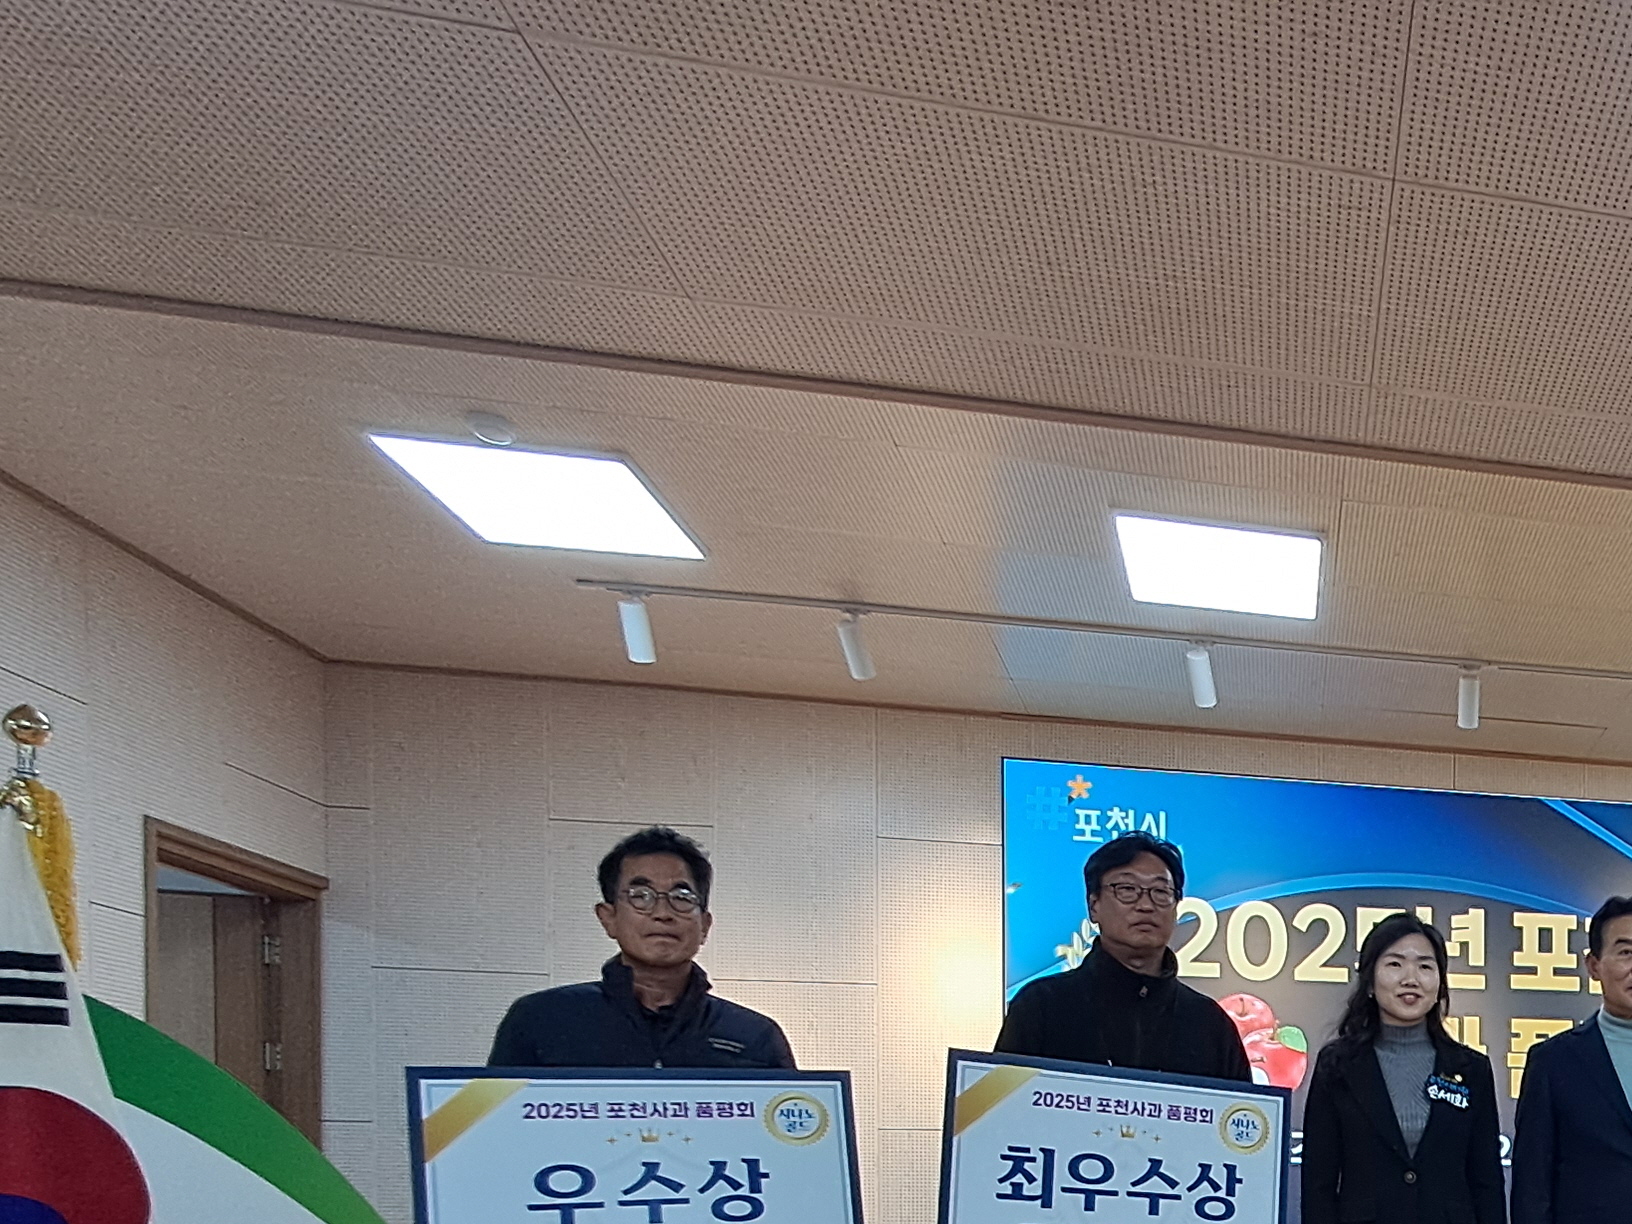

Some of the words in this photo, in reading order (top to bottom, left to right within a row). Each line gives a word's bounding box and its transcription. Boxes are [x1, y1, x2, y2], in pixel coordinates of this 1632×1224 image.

[1072, 807, 1168, 843] 포천시
[1176, 897, 1487, 991] 202년
[522, 1102, 602, 1121] 2025년
[605, 1102, 691, 1120] 포천사과
[695, 1102, 756, 1120] 품평회
[1031, 1090, 1093, 1112] 2025년
[1096, 1096, 1164, 1120] 포천사과
[1166, 1104, 1215, 1126] 품평회
[995, 1145, 1244, 1222] 최우수상
